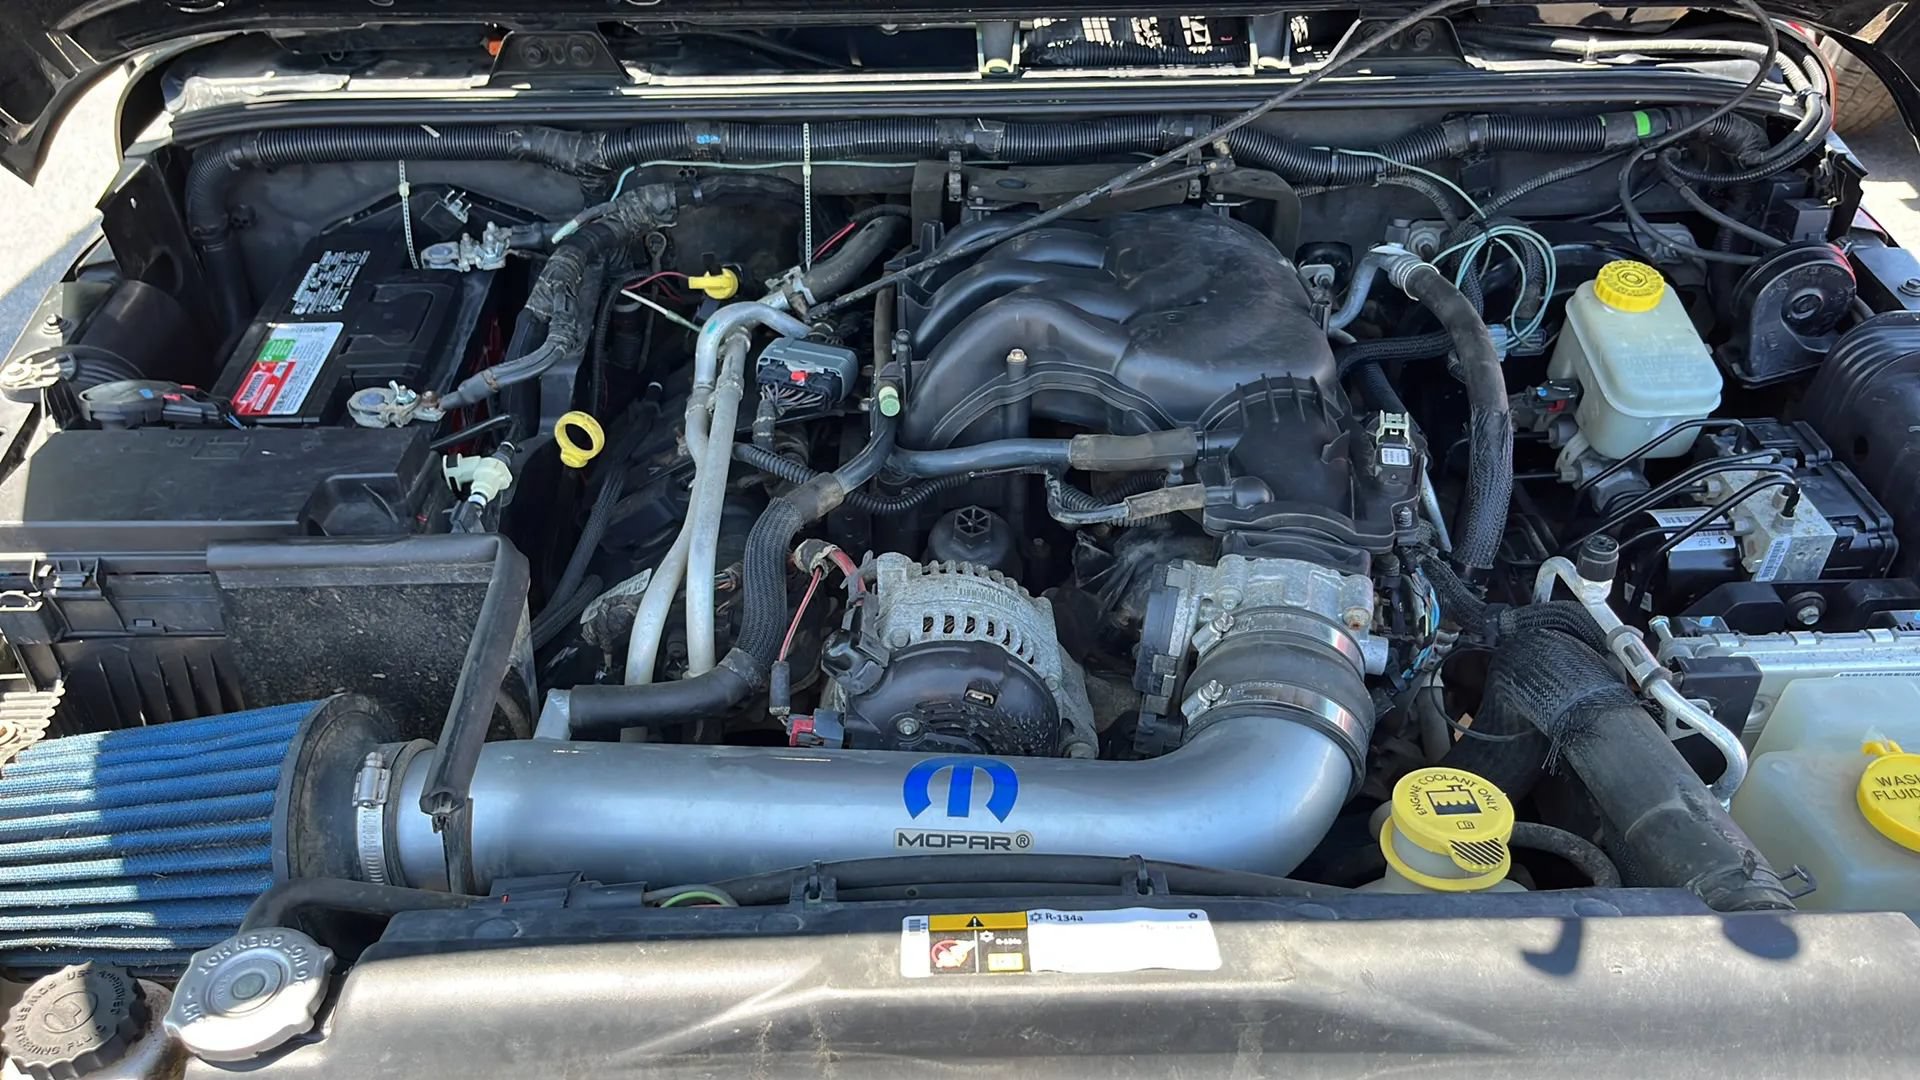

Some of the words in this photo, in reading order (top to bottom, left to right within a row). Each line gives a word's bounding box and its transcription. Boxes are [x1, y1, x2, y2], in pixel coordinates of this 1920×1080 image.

[1418, 773, 1477, 788] COOLANT
[1409, 784, 1428, 816] ENGINE
[1478, 787, 1500, 813] ONLY
[1872, 788, 1920, 801] FLUID
[1045, 912, 1084, 923] R-134a
